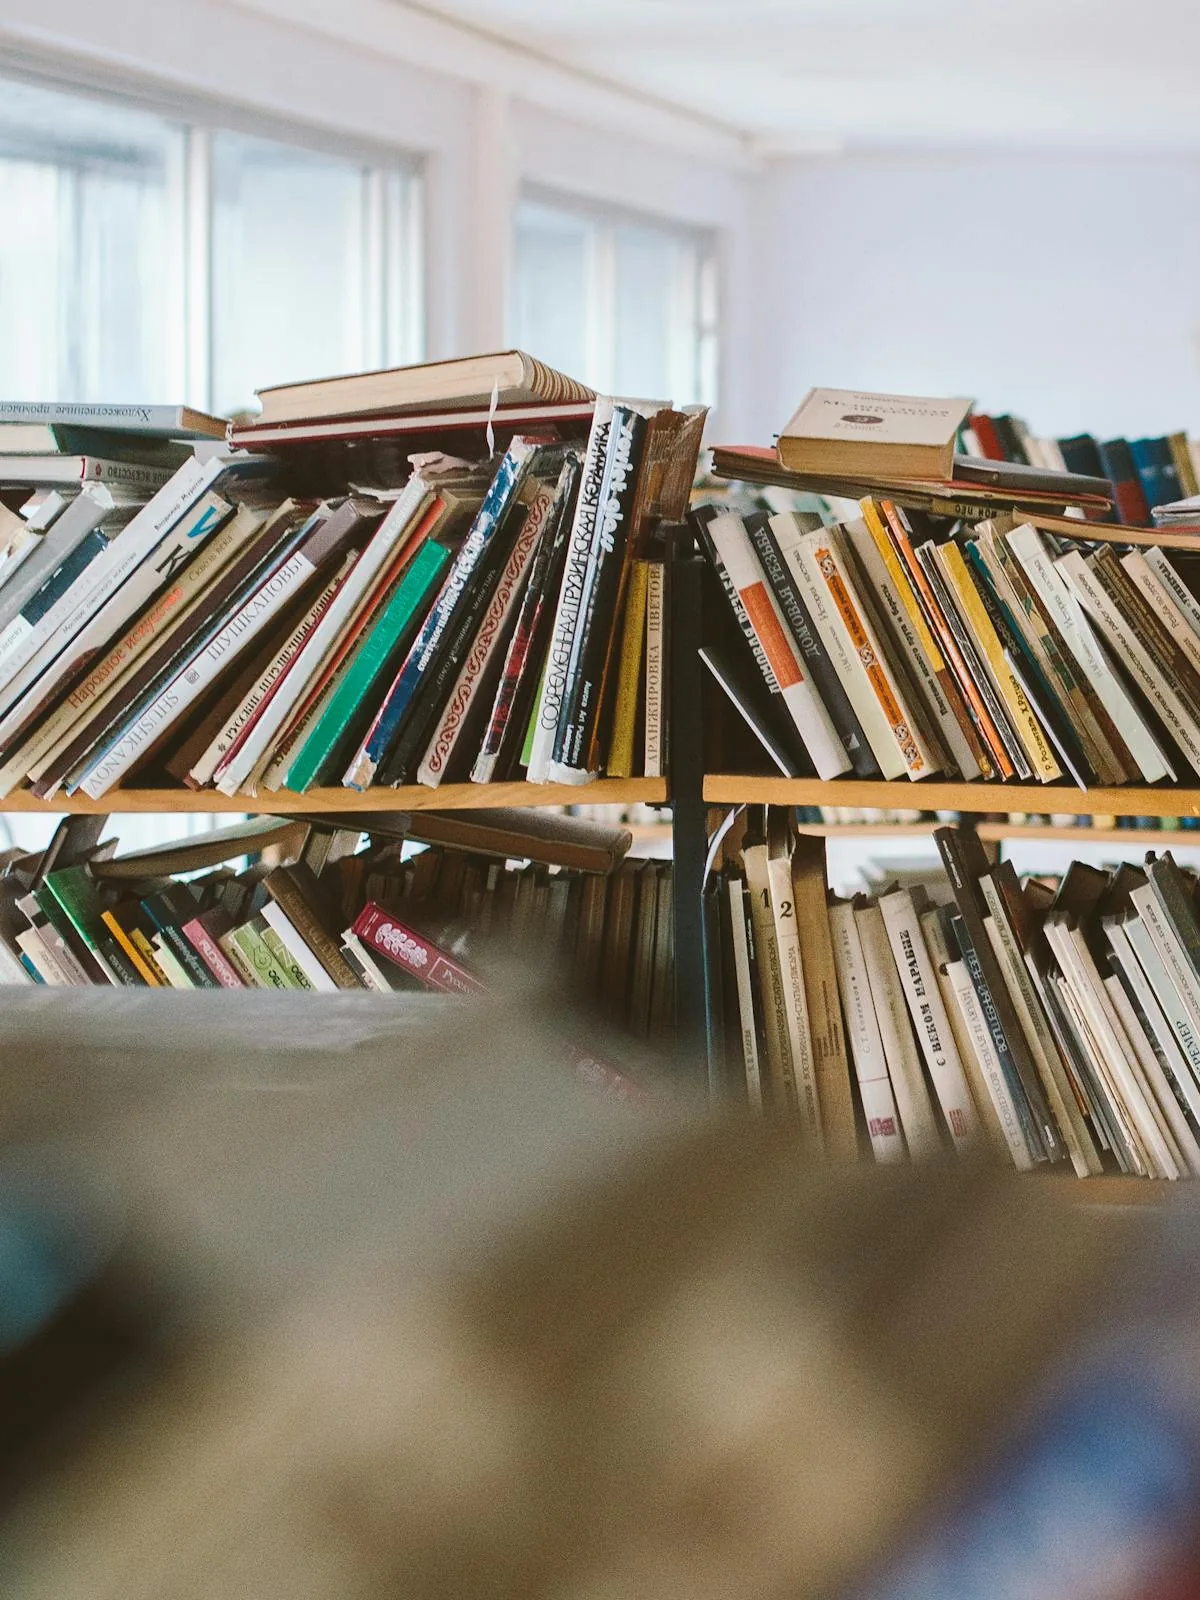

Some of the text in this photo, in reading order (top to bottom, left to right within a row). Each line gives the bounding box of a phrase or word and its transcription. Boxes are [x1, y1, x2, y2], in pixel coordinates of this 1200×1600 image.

[55, 403, 151, 420] Художественные
[610, 426, 635, 492] soviet
[539, 418, 611, 731] СОВРЕМЕННАЯ ГРУЗИНСКАЯ КЕРАМИКА
[751, 525, 820, 659] ДОМОВАЯ РЕЗЬБА
[205, 555, 303, 661] ШУШКАНОВЫ
[806, 585, 828, 621] История
[878, 582, 900, 616] бересты
[1100, 609, 1119, 632] работ
[66, 646, 127, 710] Народное
[122, 585, 186, 651] искусство
[899, 623, 915, 646] прута
[647, 570, 660, 763] АРАНЖИРОВКА ЦВЕТОВ
[1115, 631, 1157, 691] художественных
[224, 692, 262, 739] РУССКИЕ
[570, 680, 591, 764] Aurora Art Publishers
[1152, 690, 1181, 729] любителю
[85, 689, 180, 791] SHUSHKANOV
[560, 724, 574, 762] Leningrad
[1025, 716, 1048, 761] Розенталь
[1178, 728, 1200, 758] ответов
[760, 887, 770, 909] 1
[780, 900, 793, 919] 2
[898, 928, 946, 1067] С ВЕКОМ НАРАВНЕ
[964, 948, 1008, 1053] ВОЛШЕБНЫЙ РЕЗЕЦ
